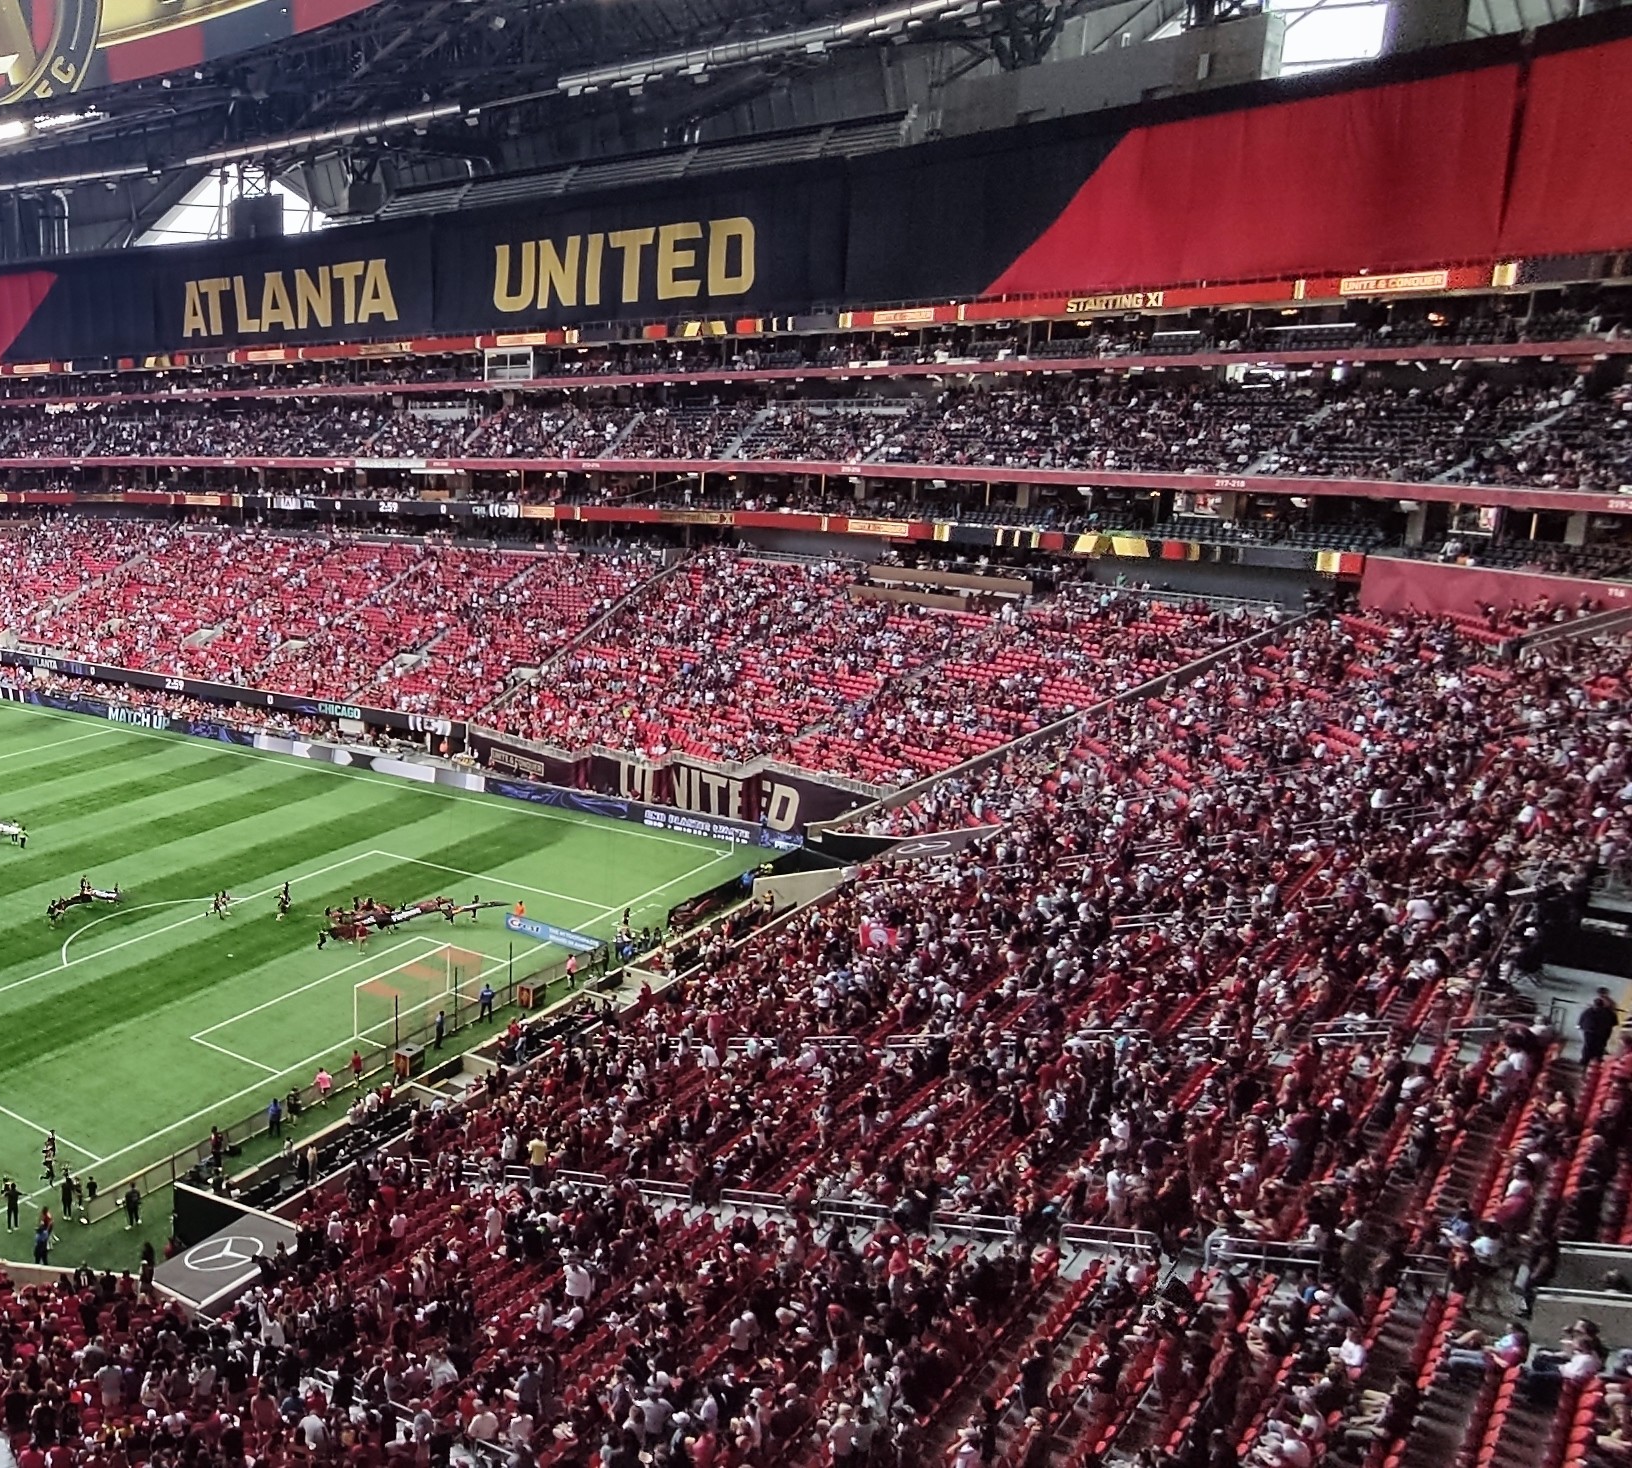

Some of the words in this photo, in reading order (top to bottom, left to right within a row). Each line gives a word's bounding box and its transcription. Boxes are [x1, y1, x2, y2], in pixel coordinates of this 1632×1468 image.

[183, 258, 399, 339] ATLANTA
[493, 216, 755, 312] UNITED
[1066, 294, 1144, 313] STARTING
[1146, 291, 1163, 307] XI
[379, 502, 398, 512] 2:59
[165, 678, 184, 691] 2:59
[318, 702, 361, 720] CHICAGO
[107, 706, 152, 728] MATCH
[153, 713, 170, 730] UP
